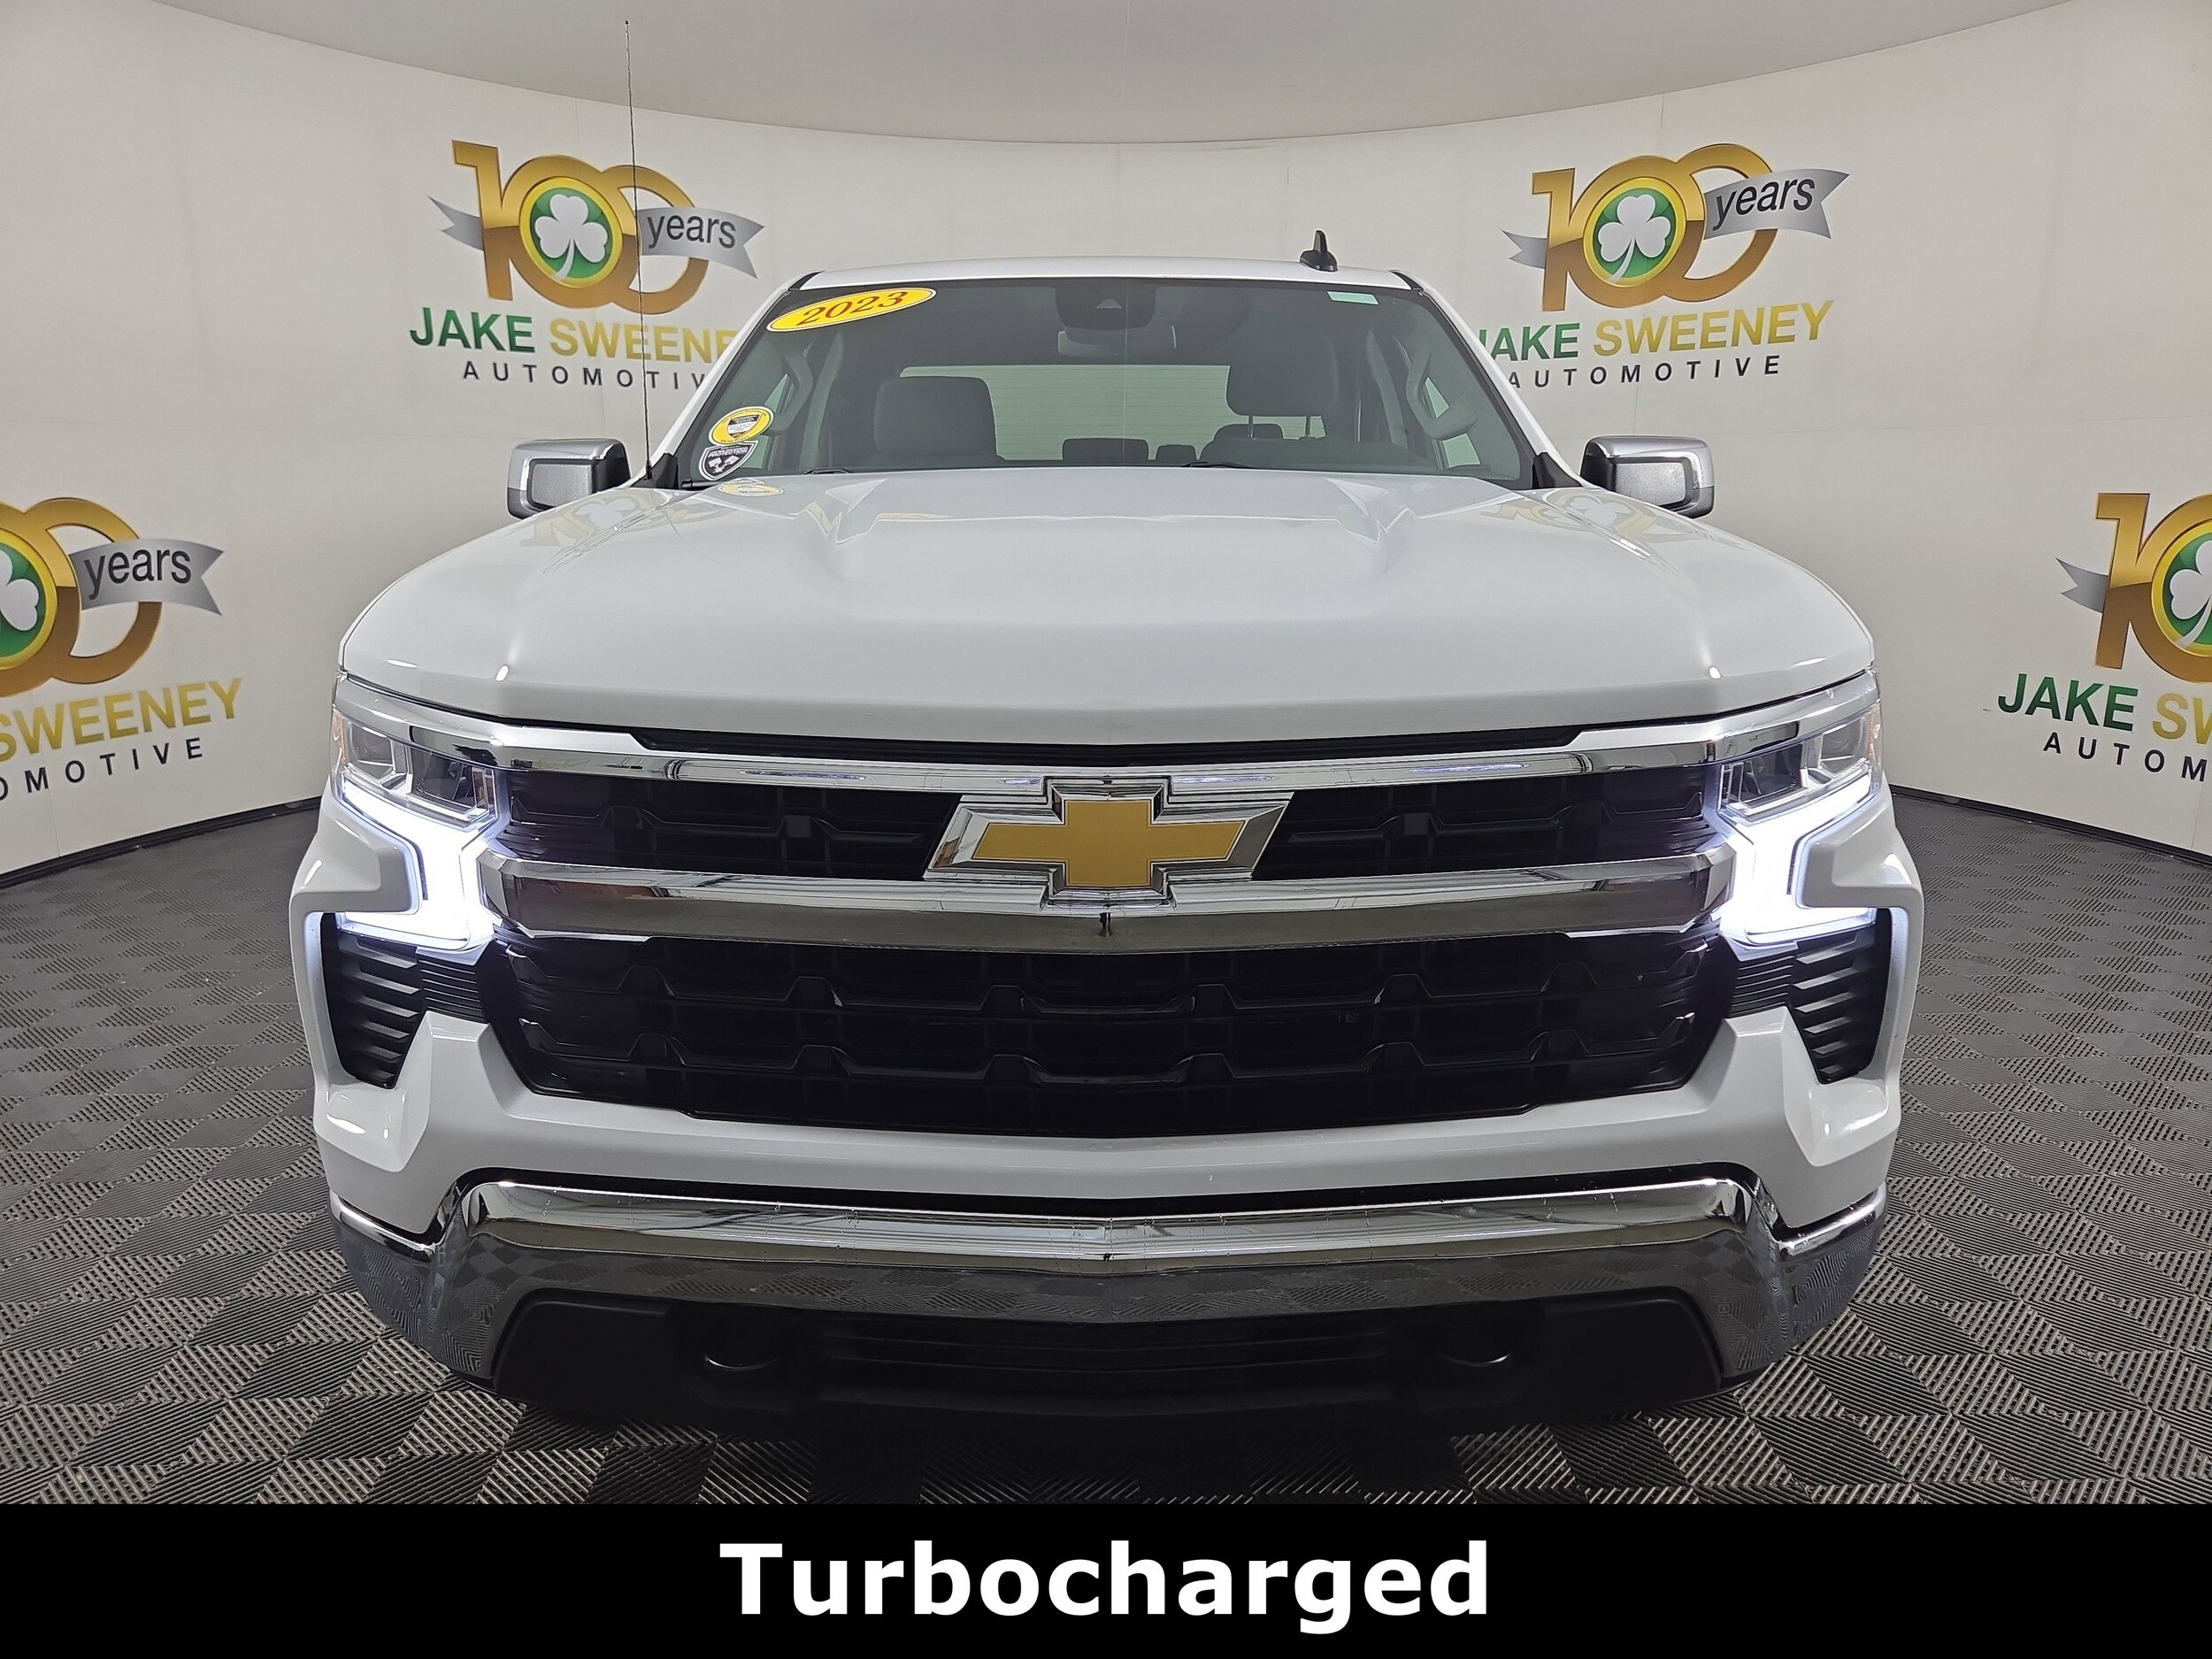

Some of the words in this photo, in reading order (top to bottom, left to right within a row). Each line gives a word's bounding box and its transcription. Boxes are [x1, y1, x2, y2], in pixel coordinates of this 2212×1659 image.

[1712, 178, 1816, 232] years
[647, 213, 737, 250] years
[410, 307, 536, 353] JAKE
[795, 290, 908, 326] 2023
[1594, 299, 1835, 357] SWEENEY
[1509, 355, 1781, 389] AUTOMOTIVE
[84, 549, 192, 600] years
[1998, 672, 2139, 732] JAKE
[2043, 732, 2208, 782] AUTOM
